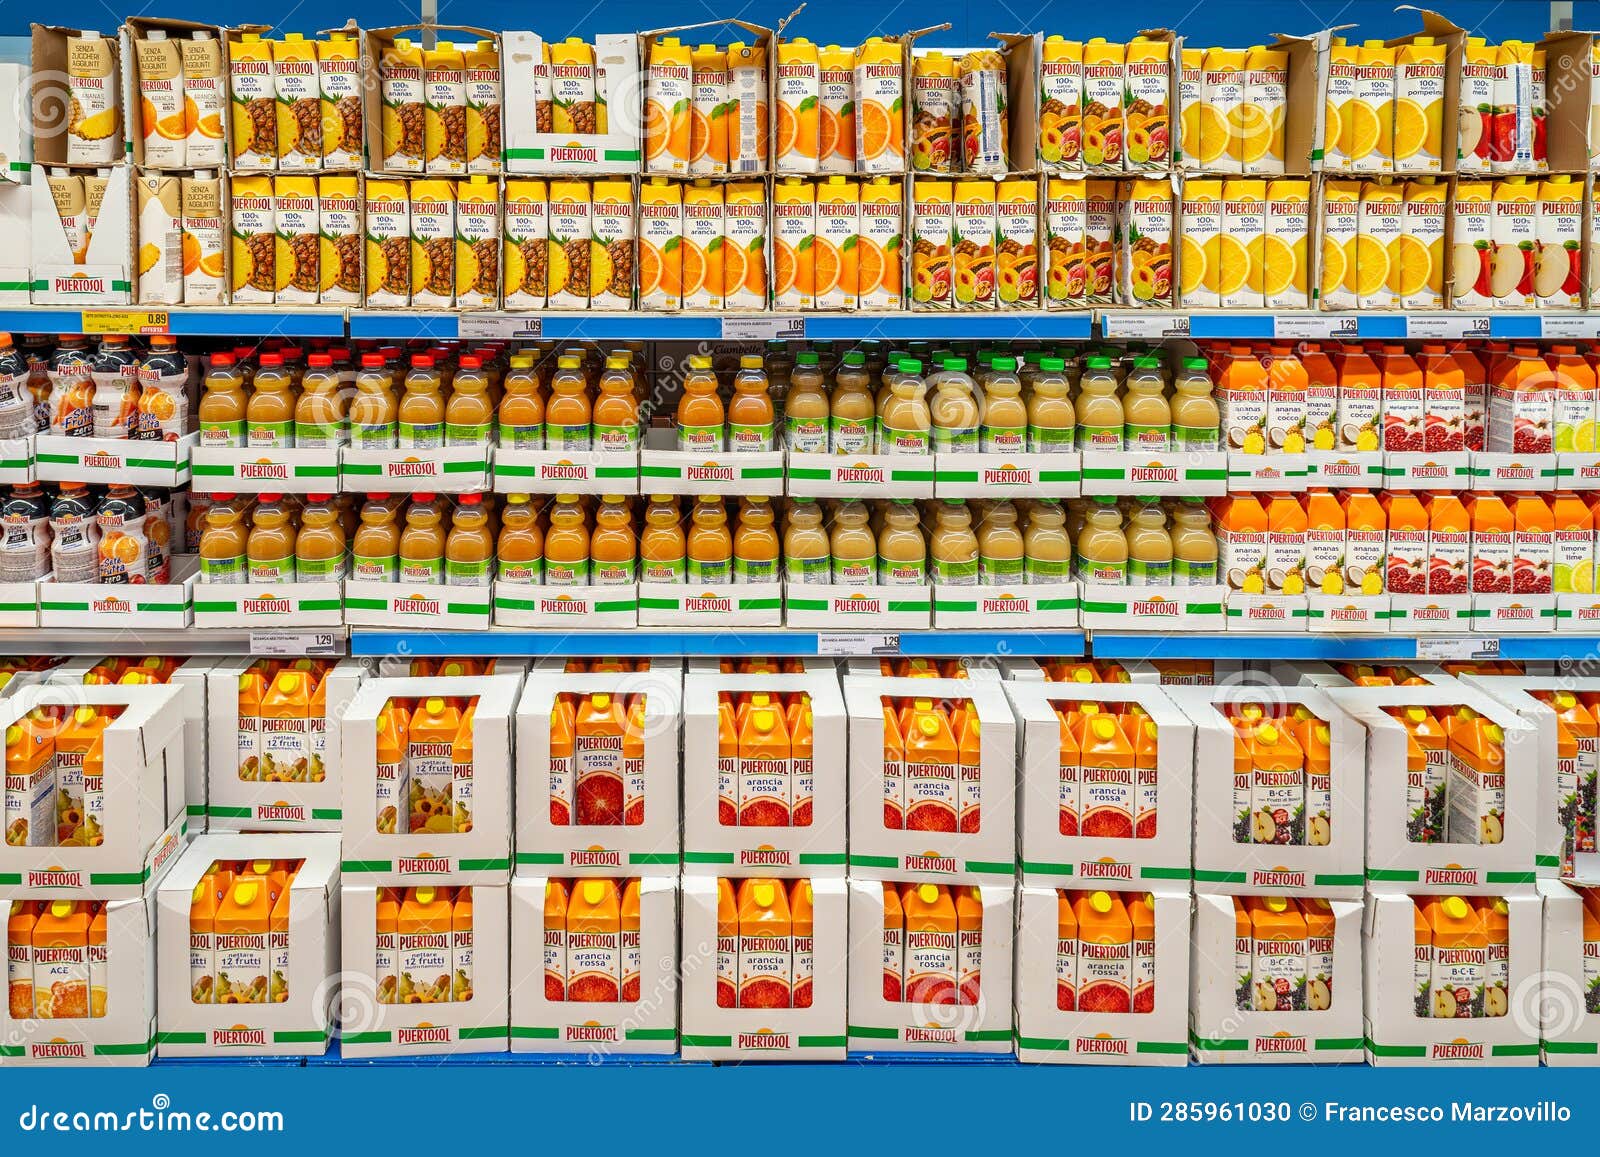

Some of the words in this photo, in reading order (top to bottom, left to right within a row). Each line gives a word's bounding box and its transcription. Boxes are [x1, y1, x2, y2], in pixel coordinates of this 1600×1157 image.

[320, 62, 359, 73] PUERTOSOL
[551, 148, 597, 161] PUERTOSOL
[459, 204, 496, 215] PUERTOSOL
[819, 205, 856, 216] PUERTOSOL
[187, 218, 219, 228] PUERTOSOL
[56, 279, 104, 292] PUERTOSOL
[1343, 389, 1378, 399] PUERTOSOL
[85, 456, 121, 468] PUERTOSOL
[241, 464, 287, 477] PUERTOSOL
[389, 464, 436, 476] PUERTOSOL
[542, 466, 588, 479] PUERTOSOL
[688, 466, 734, 480] PUERTOSOL
[838, 469, 884, 482] PUERTOSOL
[1132, 468, 1178, 480] PUERTOSOL
[1324, 465, 1361, 475] PUERTOSOL
[1412, 467, 1448, 476] PUERTOSOL
[1497, 469, 1533, 478] PUERTOSOL
[985, 471, 1032, 483] PUERTOSOL
[1307, 531, 1343, 541] PUERTOSOL
[94, 602, 131, 611] PUERTOSOL
[244, 601, 291, 612] PUERTOSOL
[394, 600, 440, 614] PUERTOSOL
[541, 600, 587, 613] PUERTOSOL
[686, 599, 731, 611] PUERTOSOL
[835, 600, 881, 612] PUERTOSOL
[984, 600, 1029, 612] PUERTOSOL
[1133, 602, 1179, 615] PUERTOSOL
[1249, 609, 1285, 618] PUERTOSOL
[1331, 610, 1368, 619] PUERTOSOL
[1414, 609, 1449, 618] PUERTOSOL
[1497, 609, 1533, 618] PUERTOSOL
[262, 720, 306, 732] PUERTOSOL
[577, 738, 623, 749] PUERTOSOL
[411, 744, 452, 757] PUERTOSO
[741, 761, 788, 774] PUERTOSOL
[908, 764, 956, 778] PUERTOSOL
[1084, 769, 1132, 783] PUERTOSOL
[1255, 771, 1302, 786] PUERTOSOL
[258, 807, 305, 819] PUERTOSOL
[571, 852, 621, 865] PUERTOSOL
[741, 852, 791, 865] PUERTOSOL
[399, 859, 451, 873] PUERTOSOL
[906, 859, 957, 872] PUERTOSOL
[1081, 863, 1132, 878] PUERTOSOL
[29, 873, 83, 887] PUERTOSOL
[1254, 872, 1306, 886] PUERTOSOL
[1426, 870, 1478, 884] PUERTOSOL
[216, 936, 265, 949] PUERTOSOL
[400, 935, 449, 948] PUERTOSOL
[569, 935, 617, 948] PUERTOSOL
[742, 938, 789, 952] PUERTOSOL
[909, 933, 955, 948] PUERTOSOL
[1082, 944, 1130, 958] PUERTOSOL
[1258, 942, 1304, 955] PUERTOSOL
[34, 950, 83, 963] PUERTOSOL
[405, 958, 416, 966] 12
[575, 953, 611, 961] arancia
[1439, 950, 1485, 964] PUERTOSOL
[214, 1030, 266, 1044] PUERTOSOL
[399, 1029, 451, 1042] PUERTOSOL
[567, 1027, 618, 1040] PUERTOSOL
[906, 1029, 957, 1042] PUERTOSOL
[739, 1035, 790, 1048] PUERTOSOL
[1077, 1039, 1128, 1054] PUERTOSOL
[1256, 1038, 1306, 1052] PUERTOSOL
[32, 1044, 86, 1057] PUERTOSOL
[1433, 1045, 1483, 1058] PUERTOSOL
